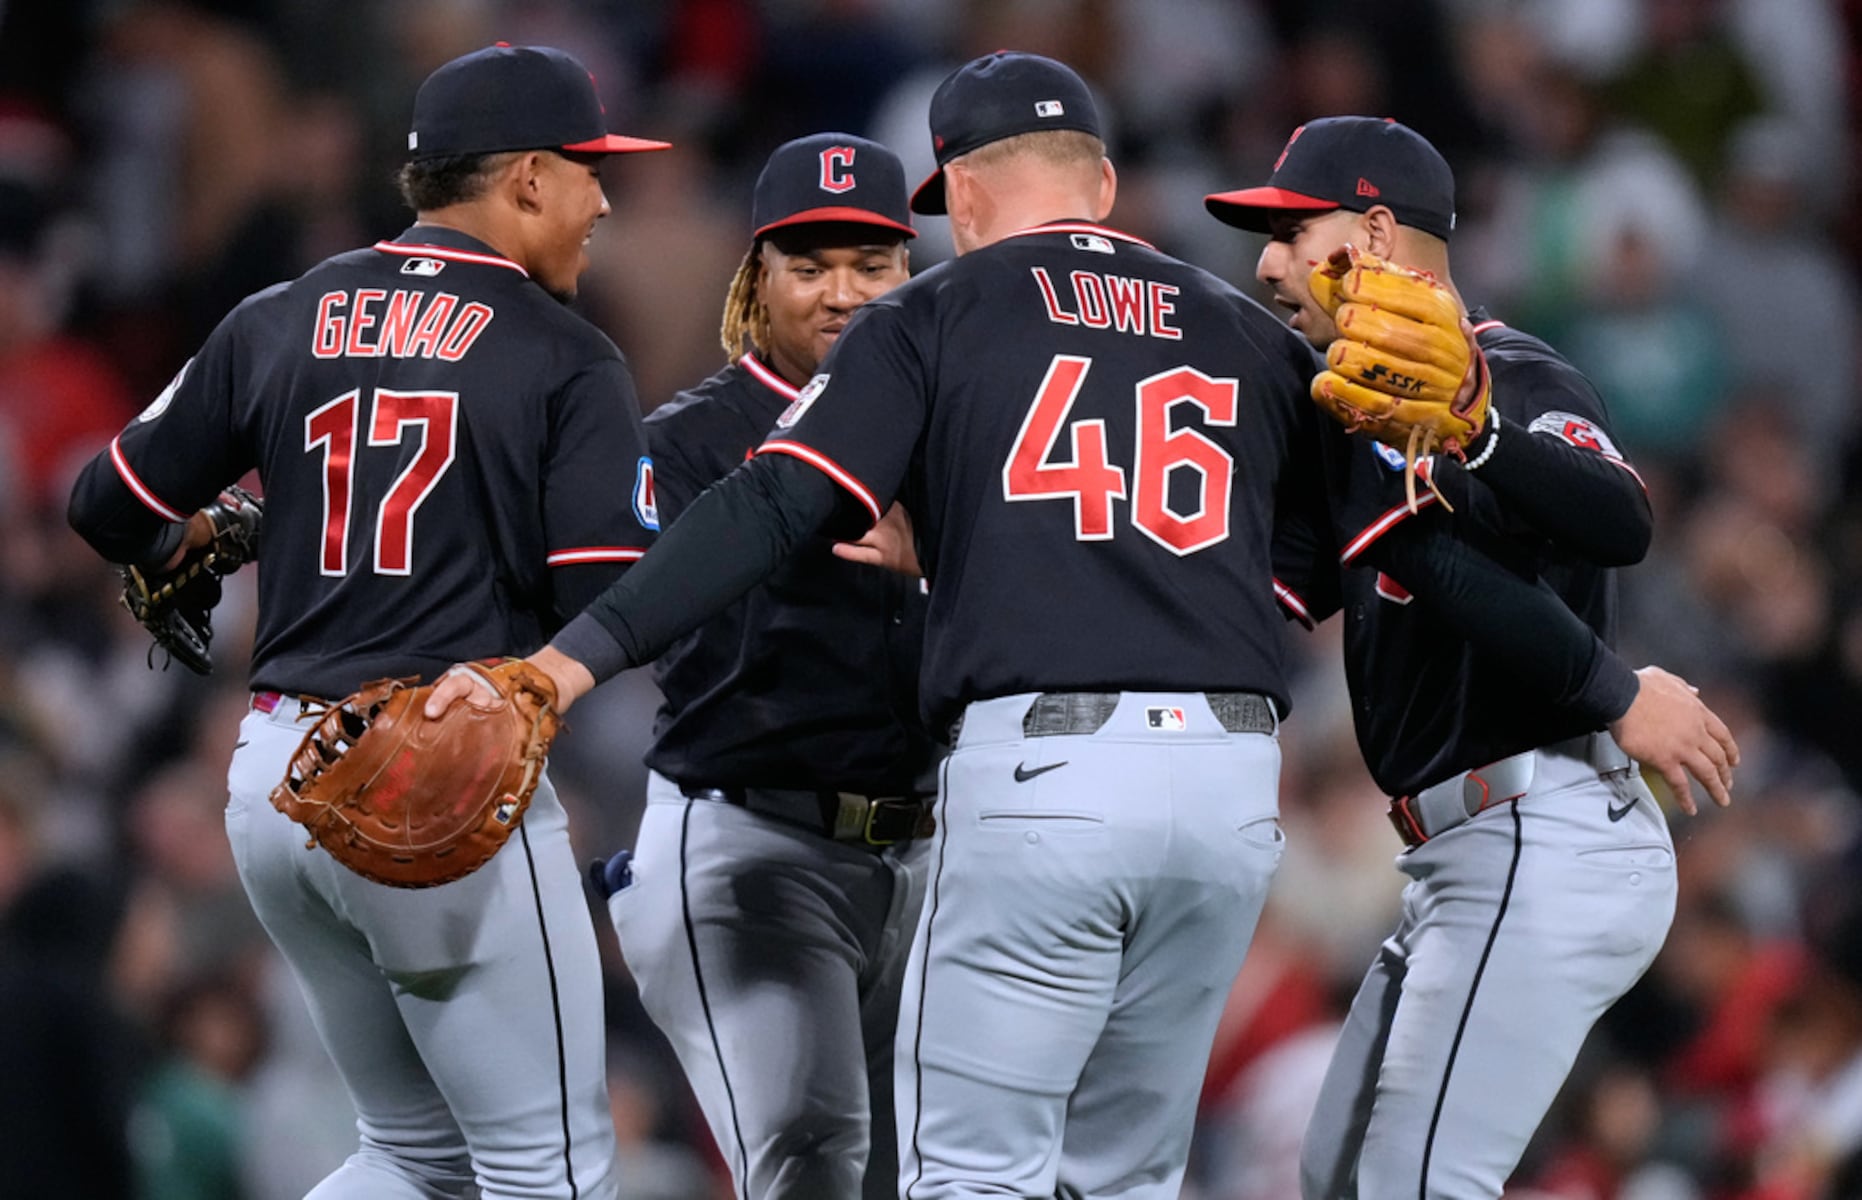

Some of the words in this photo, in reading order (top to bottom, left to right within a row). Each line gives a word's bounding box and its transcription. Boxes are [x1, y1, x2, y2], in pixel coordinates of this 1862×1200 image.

[819, 145, 856, 194] C
[312, 288, 494, 362] GENAO
[1030, 267, 1183, 340] LOWE
[1386, 372, 1427, 392] SSK
[304, 387, 459, 576] 17
[1002, 353, 1240, 557] 46
